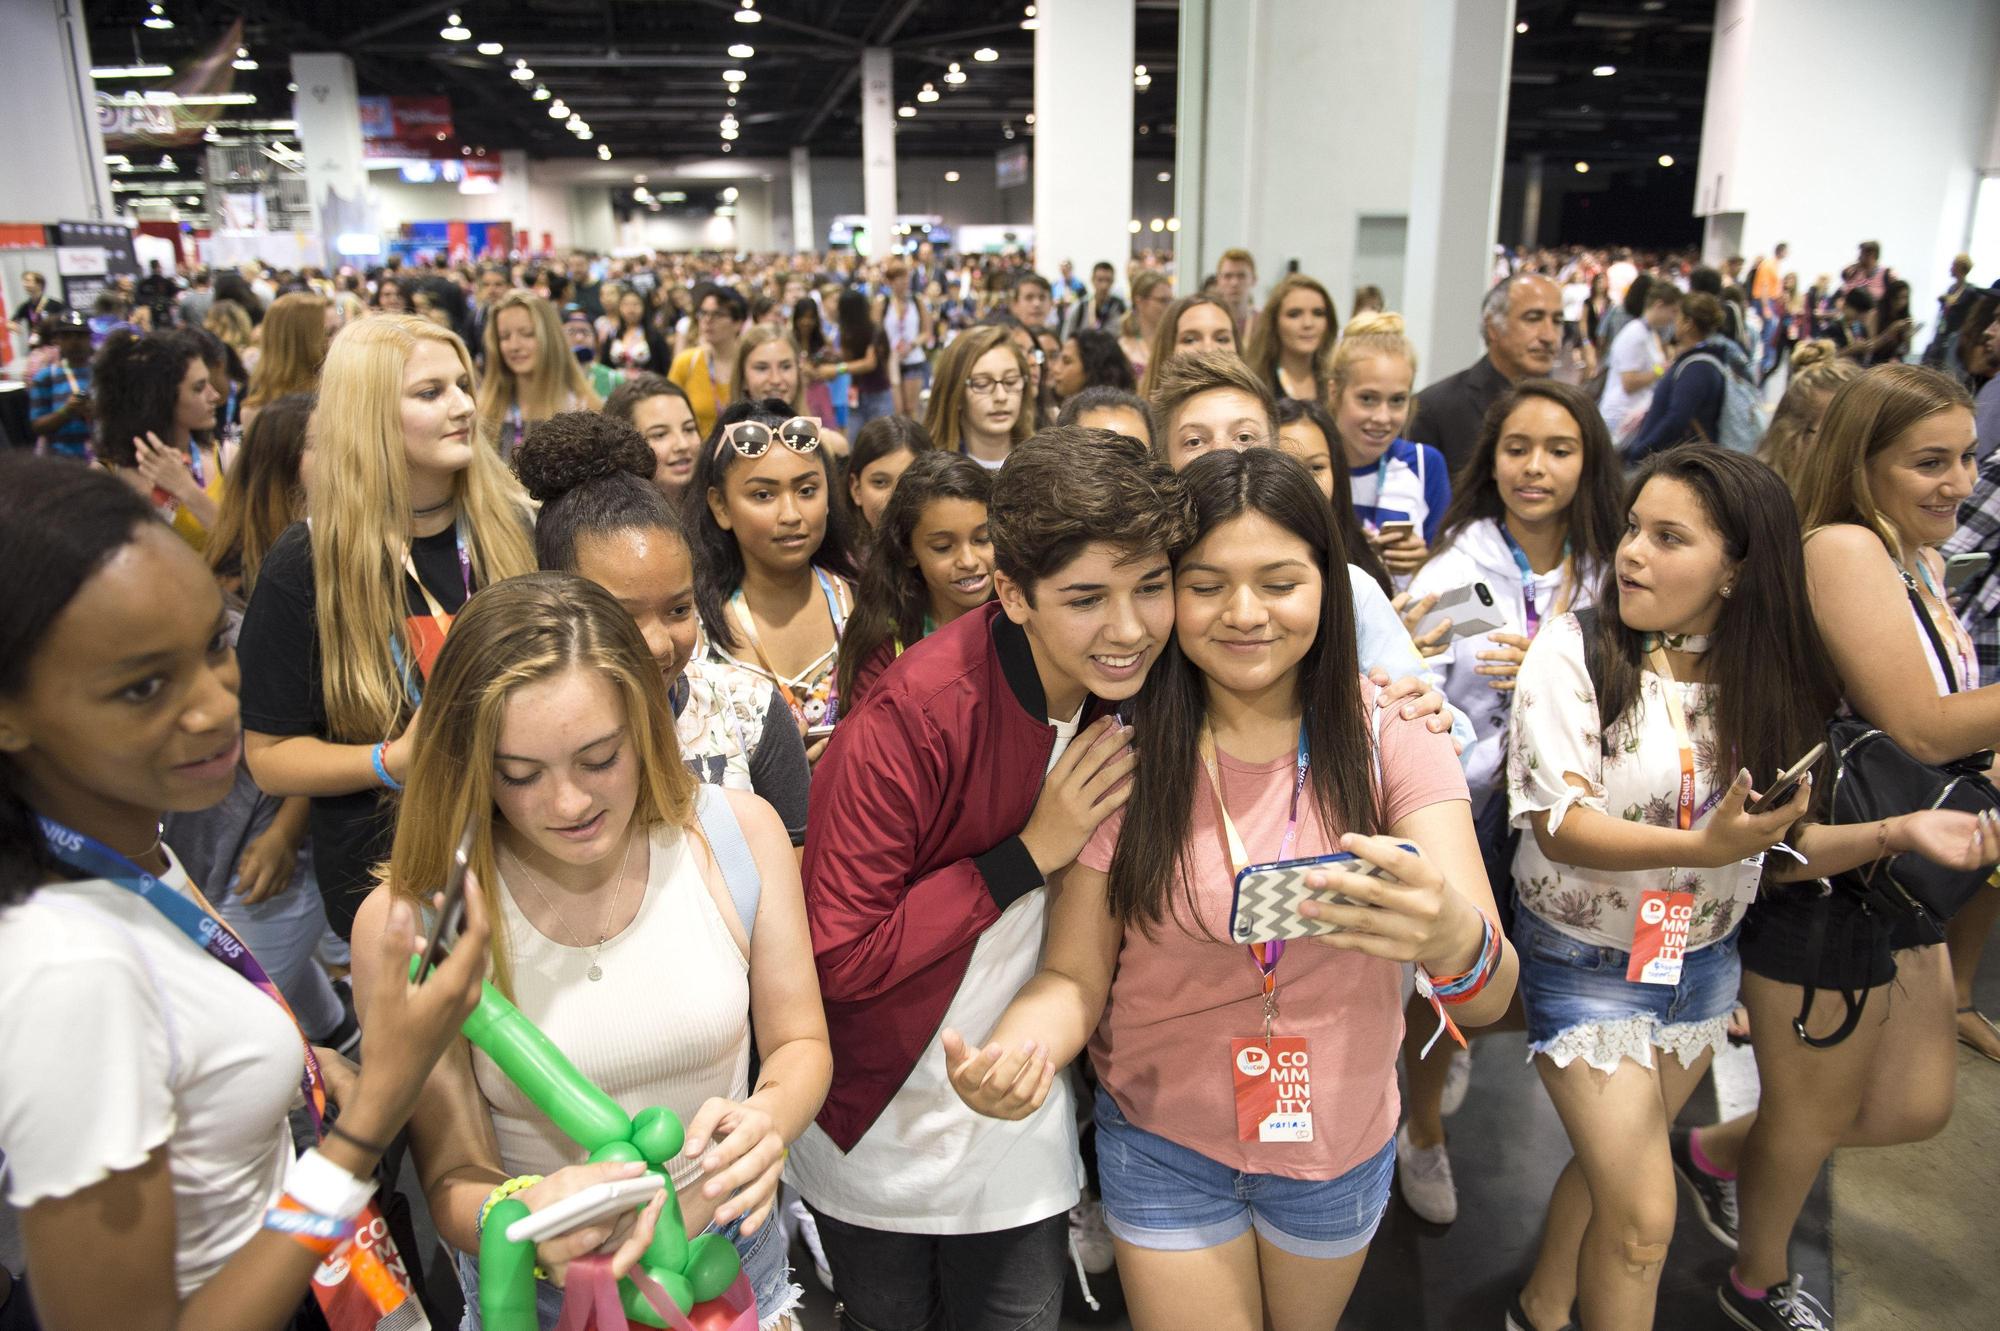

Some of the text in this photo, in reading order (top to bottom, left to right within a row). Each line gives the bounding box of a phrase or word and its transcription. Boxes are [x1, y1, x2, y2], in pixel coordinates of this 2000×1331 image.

[1680, 773, 1691, 807] GENIUS
[1670, 905, 1692, 920] CO
[1661, 918, 1690, 934] MM
[198, 917, 244, 959] GENIUS
[1664, 933, 1688, 947] UN
[1659, 946, 1686, 959] ITY
[1277, 1051, 1308, 1067] CO
[1270, 1068, 1310, 1083] MM
[1279, 1084, 1310, 1099] UN
[1276, 1099, 1311, 1114] ITY
[354, 1217, 388, 1250] CO
[374, 1235, 399, 1264] M
